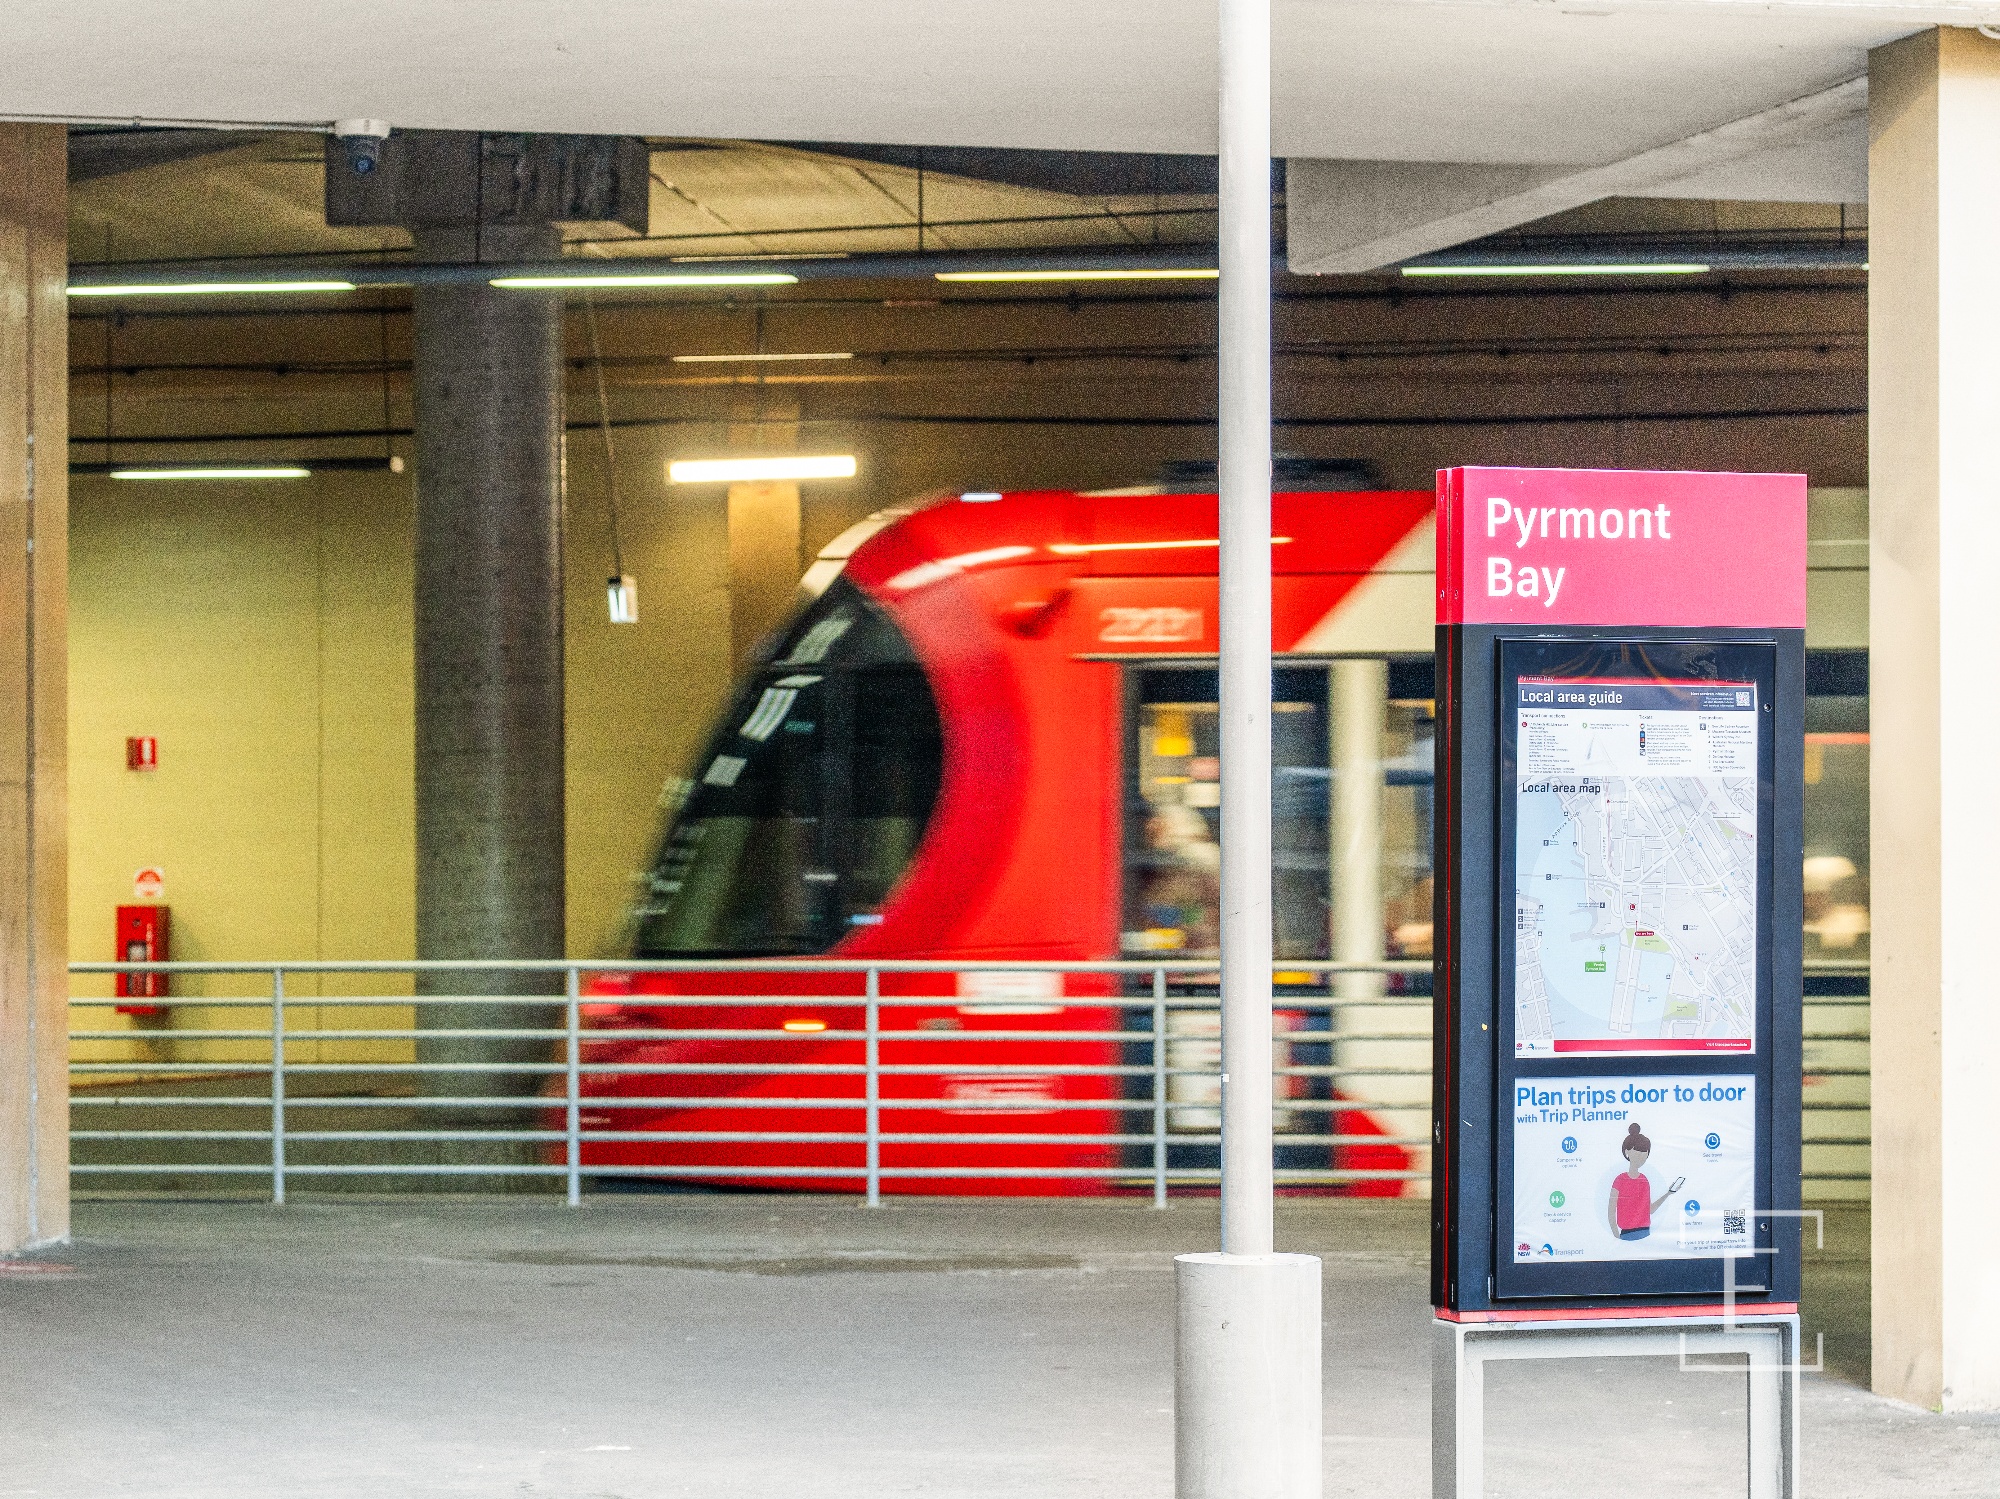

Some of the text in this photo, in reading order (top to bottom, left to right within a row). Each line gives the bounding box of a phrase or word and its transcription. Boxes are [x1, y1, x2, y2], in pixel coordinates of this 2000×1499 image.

[1487, 497, 1671, 548] Pyrmont
[1487, 557, 1566, 608] Bay
[1521, 689, 1623, 706] Local area guide
[1522, 783, 1601, 795] Local area map
[1517, 1082, 1747, 1108] Plan trips door to door
[1517, 1108, 1629, 1124] with Trip Planner
[1554, 1248, 1584, 1256] Transport
